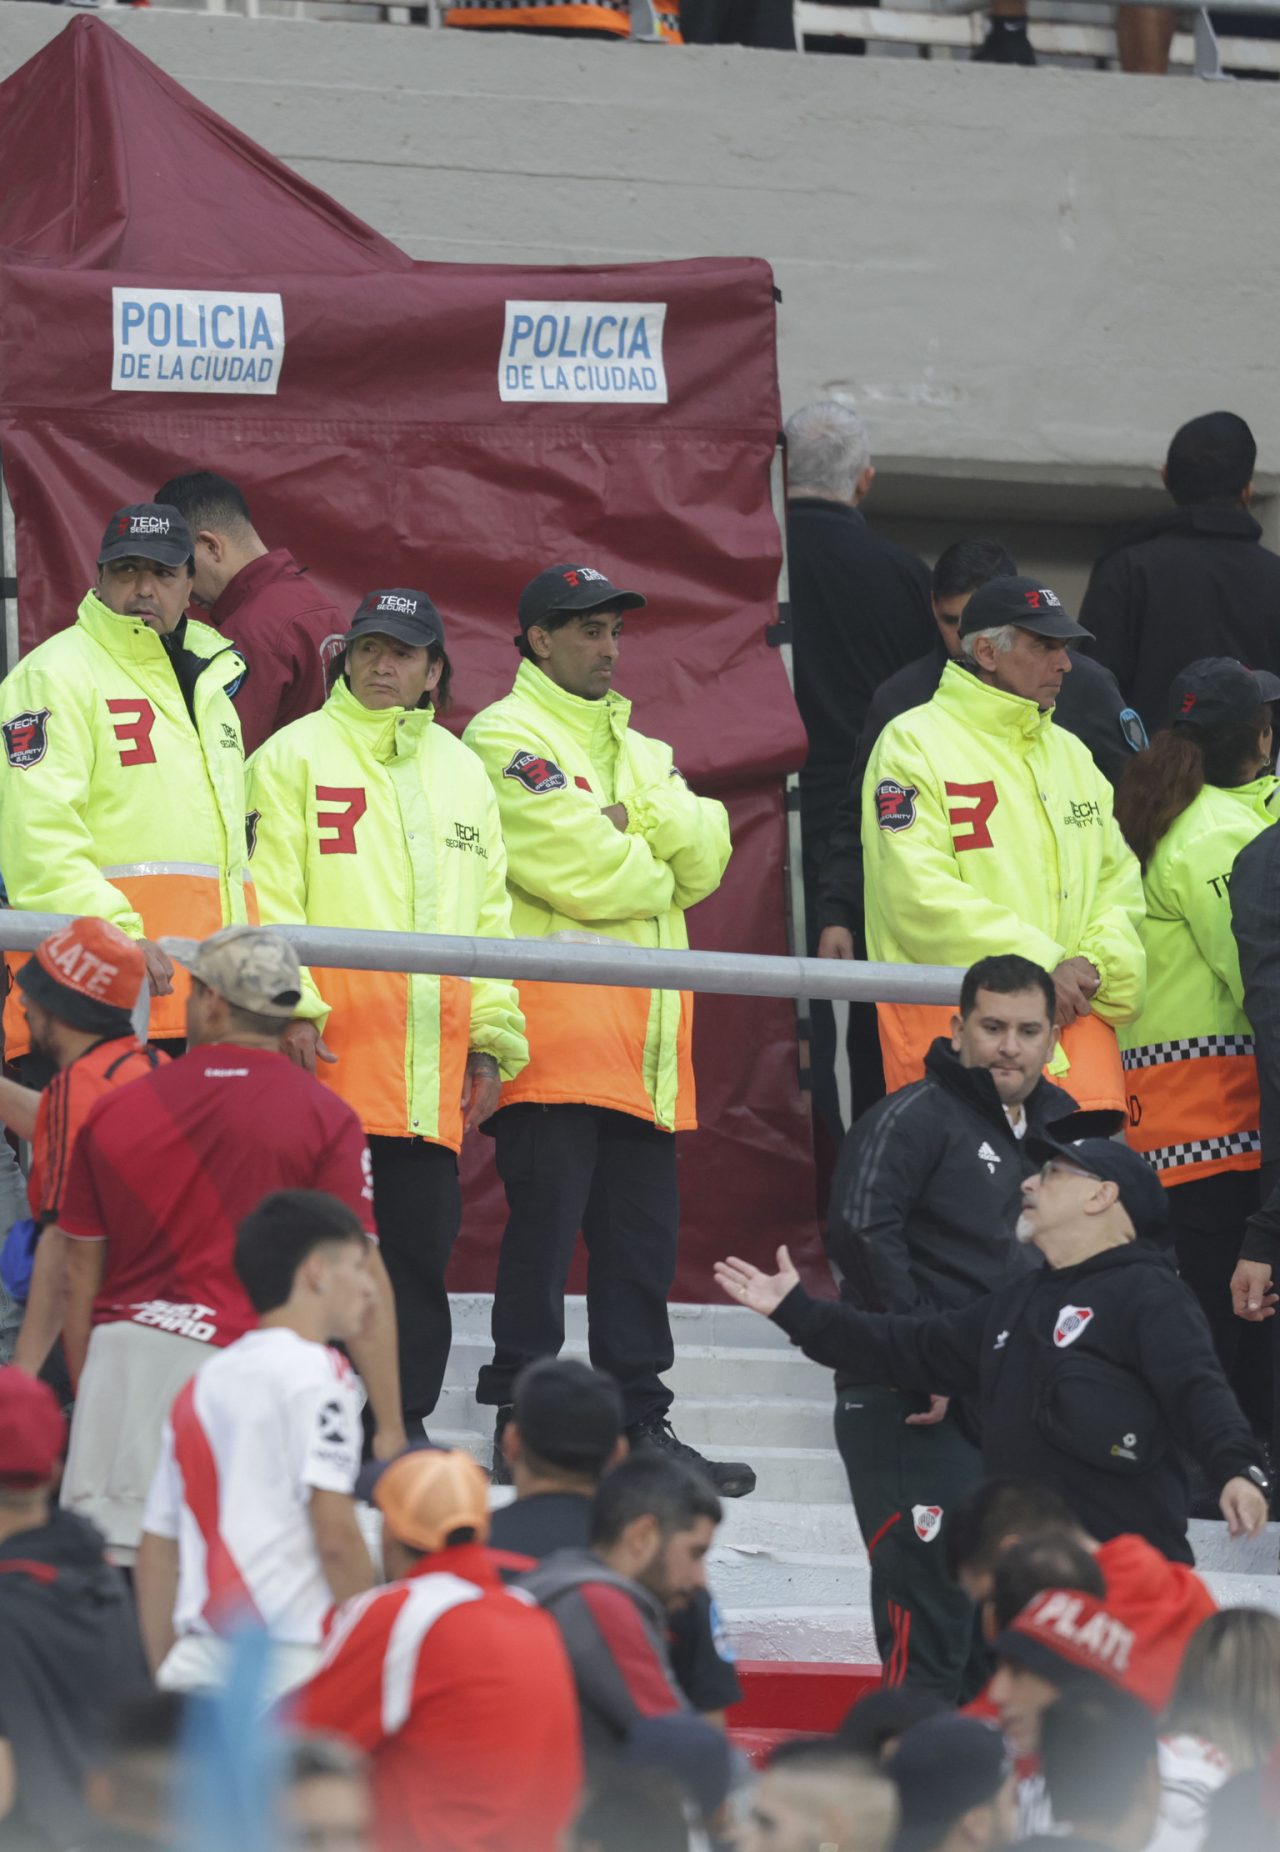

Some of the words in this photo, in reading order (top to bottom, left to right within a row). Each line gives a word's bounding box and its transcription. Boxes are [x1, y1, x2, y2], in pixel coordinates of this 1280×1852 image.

[121, 301, 275, 350] POLICIA
[508, 314, 652, 359] POLICIA
[121, 353, 151, 379] DE
[157, 354, 184, 380] LA
[190, 355, 274, 382] CIUDAD
[506, 364, 535, 390] DE
[540, 365, 569, 390] LA
[573, 365, 658, 391] CIUDAD
[130, 516, 170, 529] TECH
[130, 527, 170, 535] SECURITY
[376, 603, 417, 615] SECURITY
[380, 595, 417, 611] TECH
[6, 714, 39, 731] TECH
[9, 747, 42, 759] SECURITY
[453, 821, 480, 844] TECH
